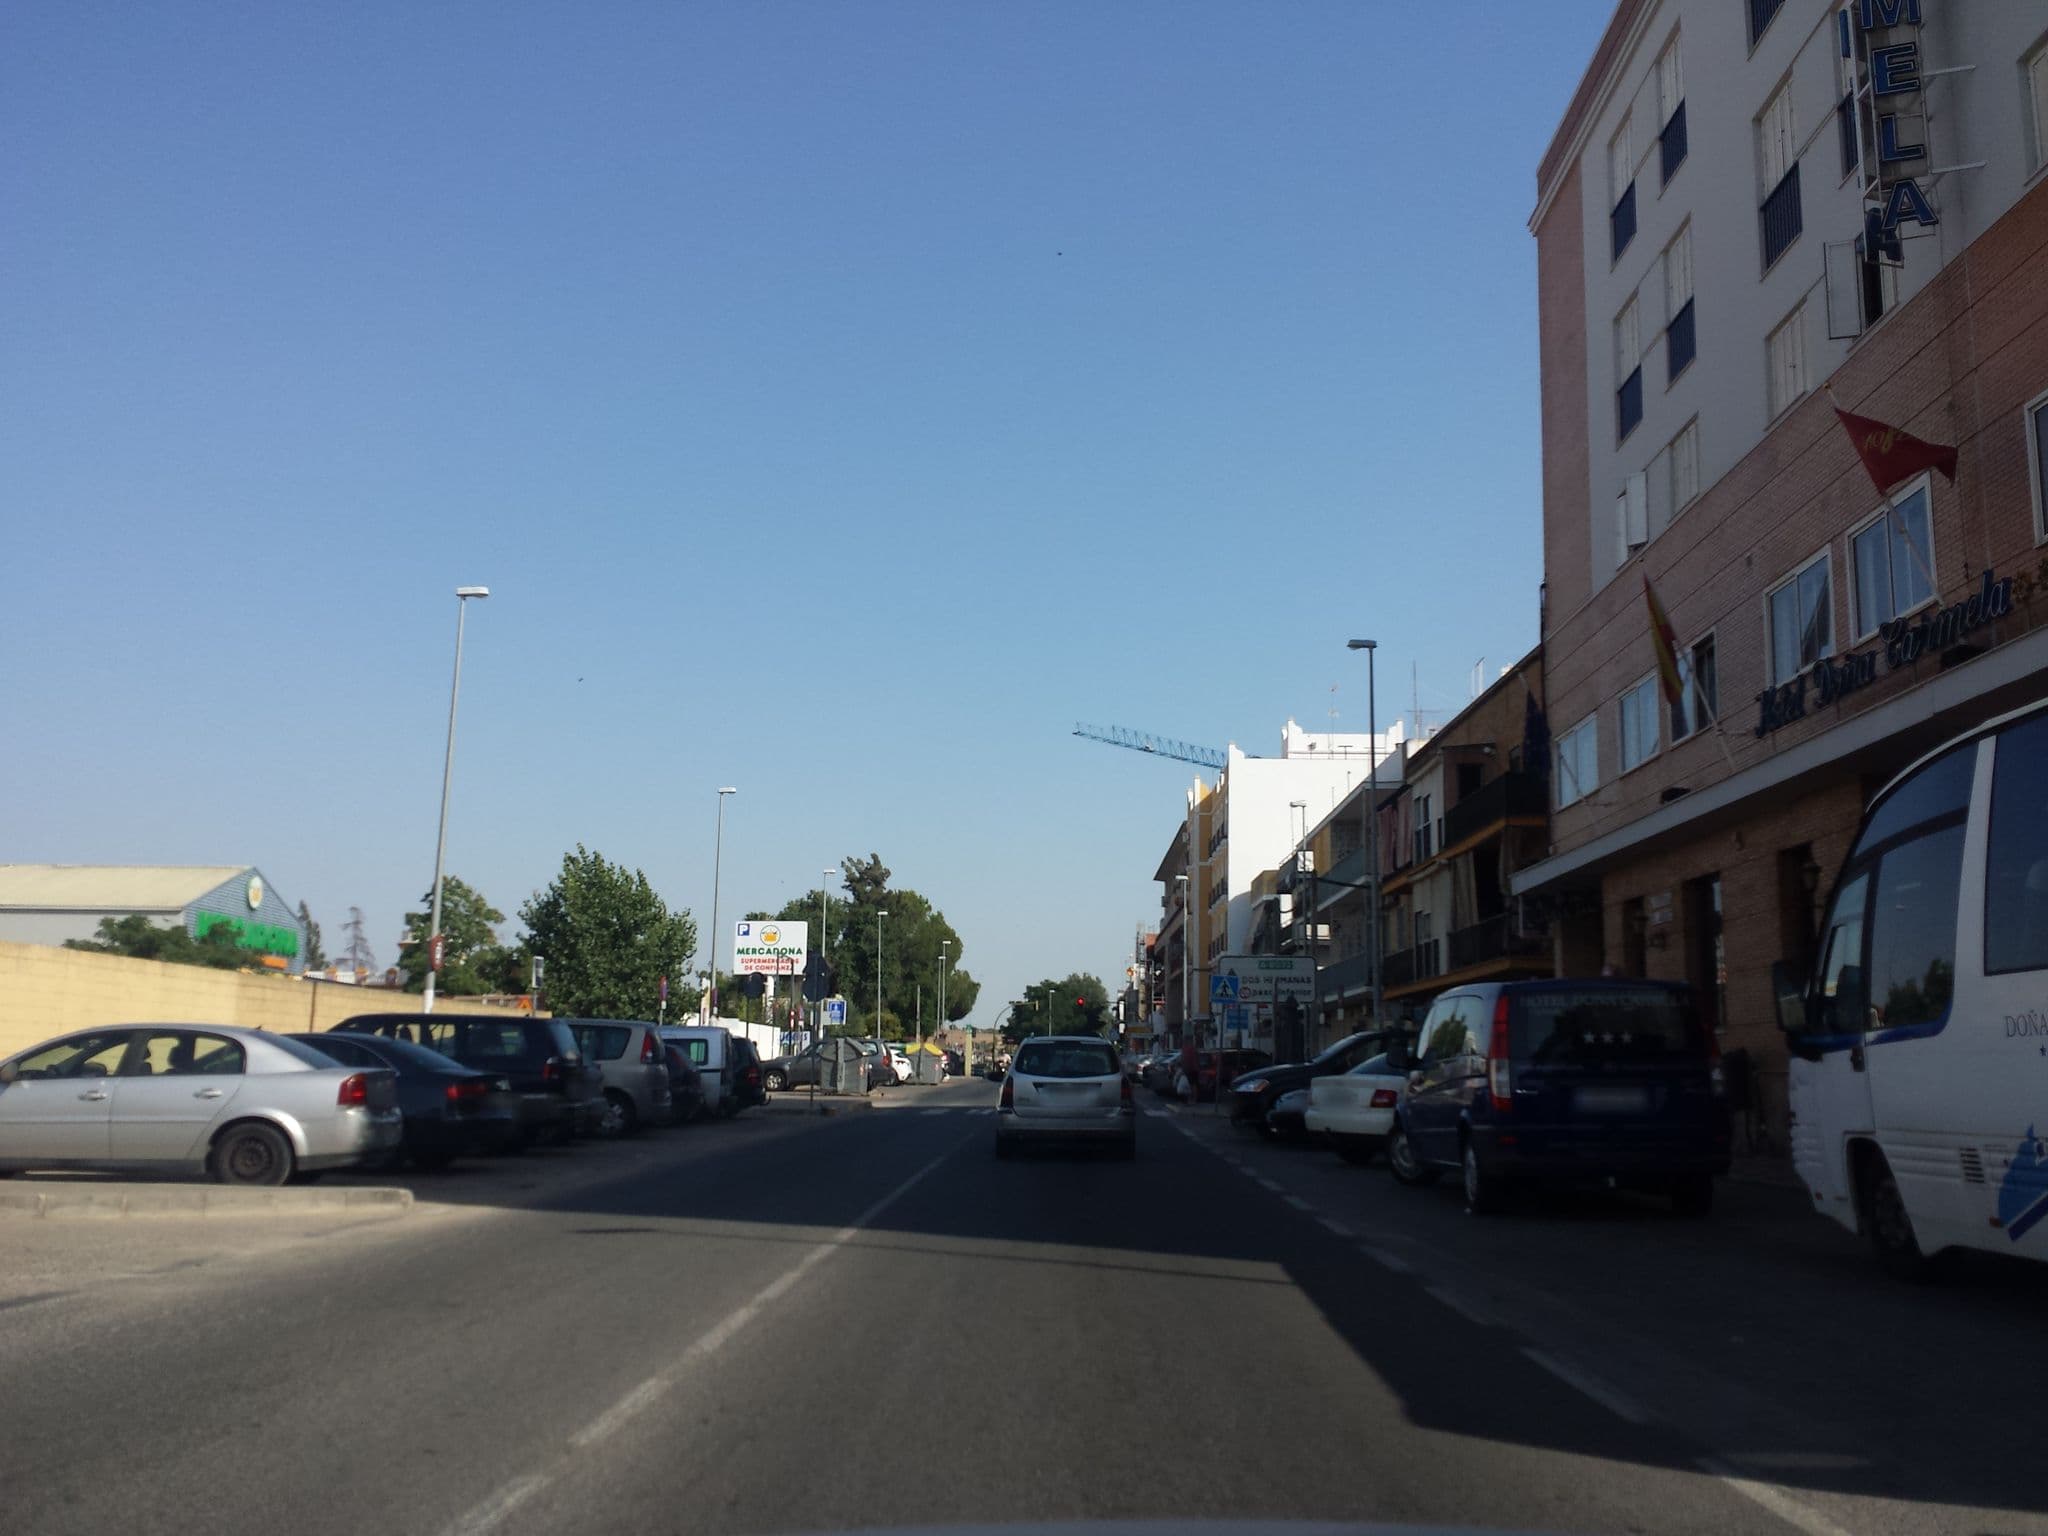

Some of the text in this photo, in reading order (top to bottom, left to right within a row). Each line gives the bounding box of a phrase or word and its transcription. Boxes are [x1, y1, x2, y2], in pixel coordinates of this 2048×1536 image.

[1878, 569, 2013, 668] Carmela
[737, 947, 803, 955] MERCADONA
[1263, 976, 1312, 984] HEMANAS
